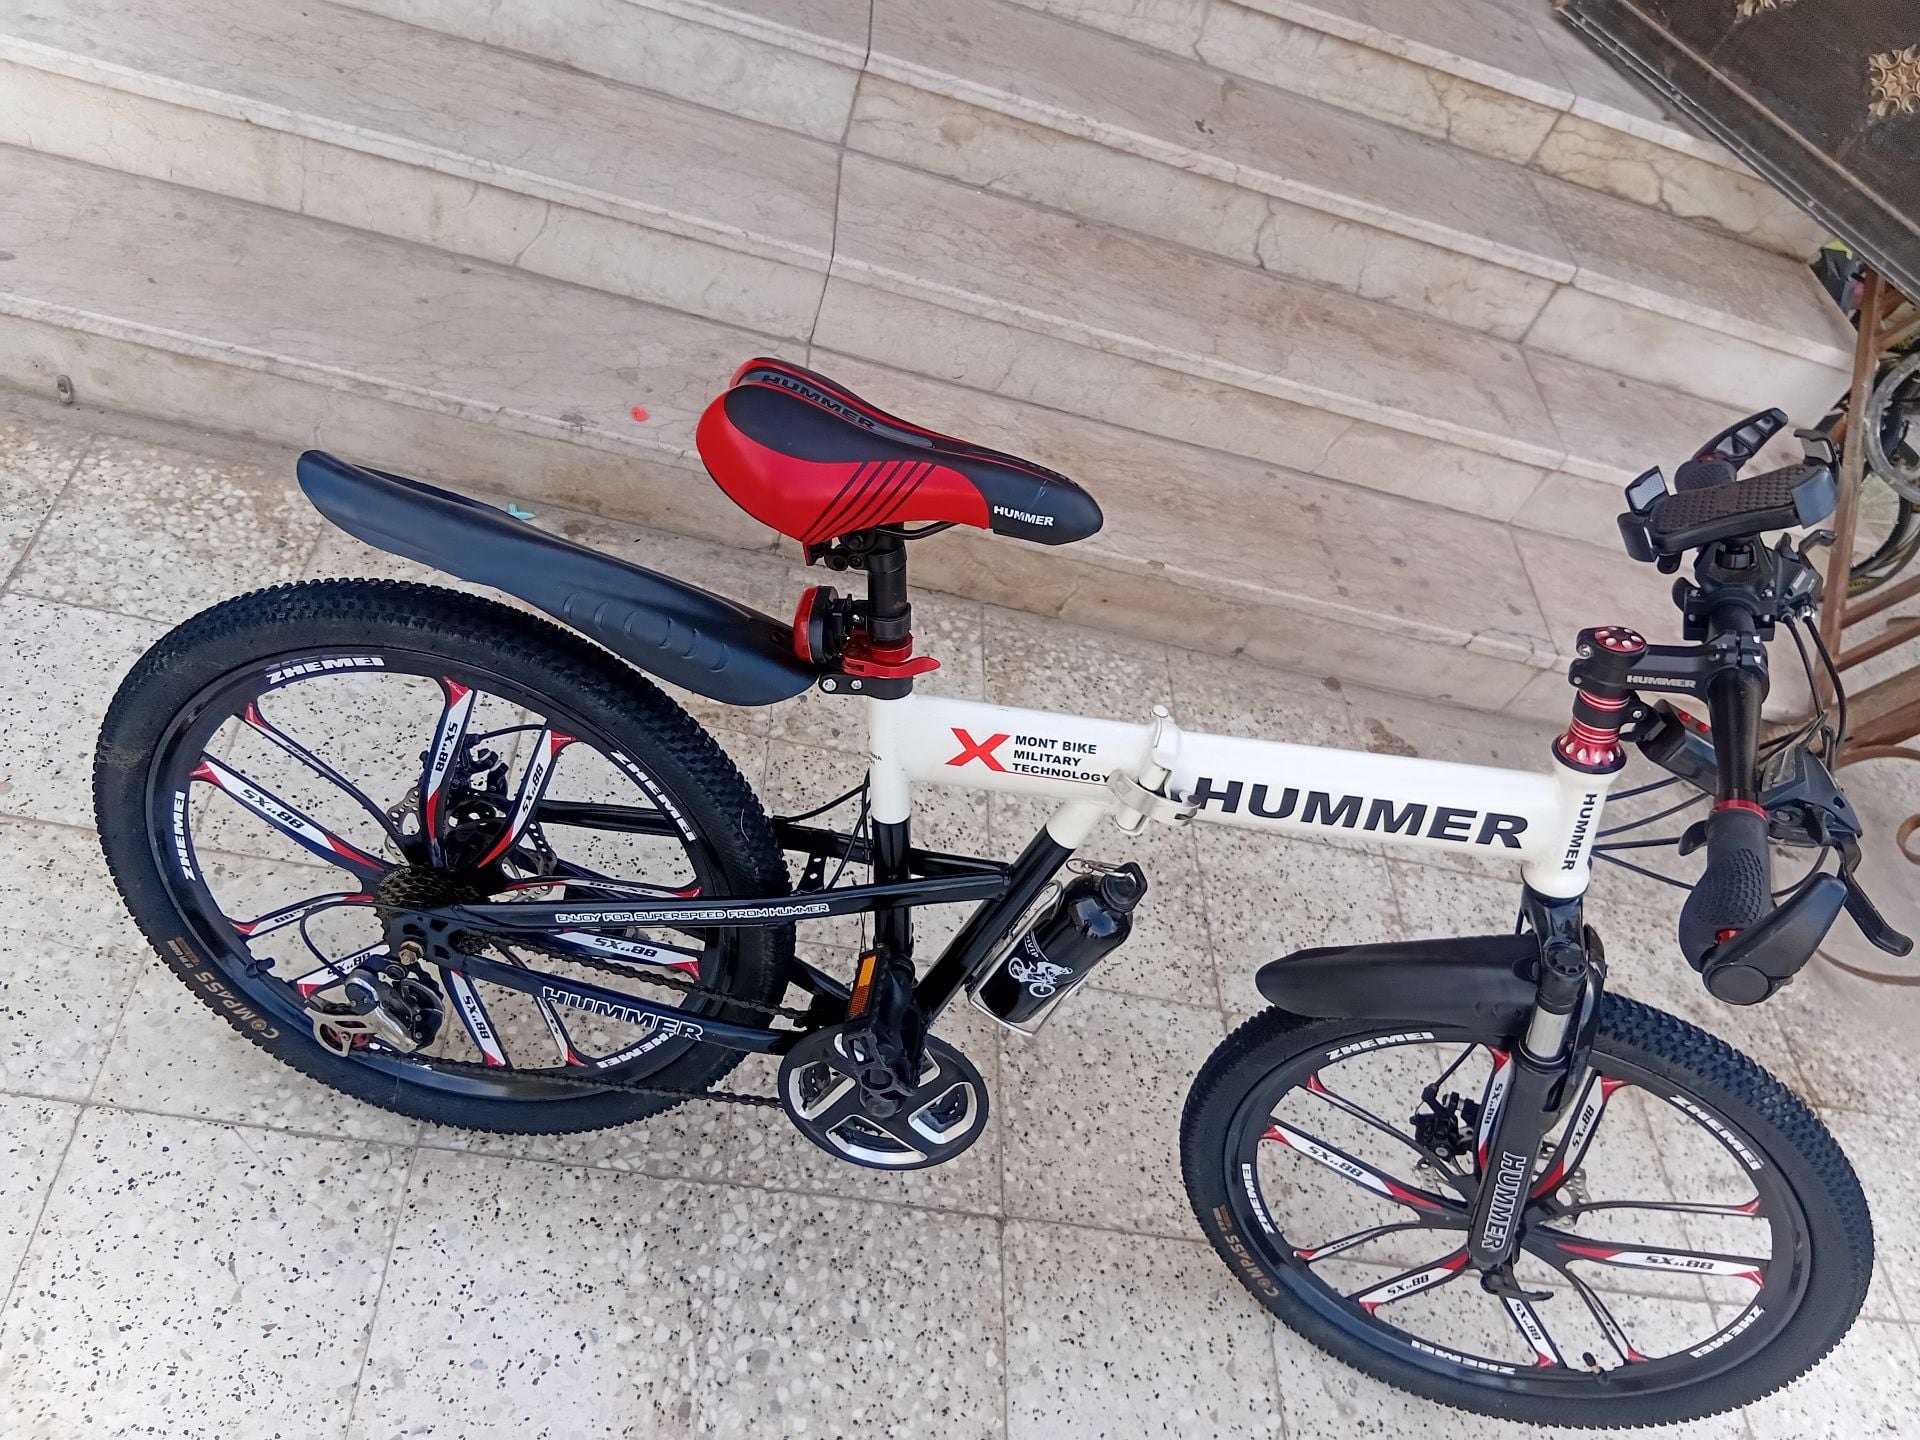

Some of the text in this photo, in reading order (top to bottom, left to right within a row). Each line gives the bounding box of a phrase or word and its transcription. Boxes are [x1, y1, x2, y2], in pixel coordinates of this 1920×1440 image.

[761, 374, 875, 431] HUMMER
[993, 504, 1055, 527] HUMMER
[266, 656, 385, 685] ZHEMEI
[1626, 674, 1697, 689] HUMMER
[944, 727, 1011, 773] X
[1011, 762, 1111, 784] TECHNOLOGY
[1012, 749, 1082, 767] MILITARY
[1014, 734, 1098, 755] MONT BIKE
[610, 749, 697, 842] ZHEMEI
[1195, 776, 1529, 850] HUMMER
[172, 790, 196, 882] ZHEMEI
[1561, 792, 1598, 871] HUMMER
[554, 902, 831, 924] ENJOY FOR SUPERSPEED FROM HUMMER
[194, 970, 280, 1040] COMPASS
[542, 985, 705, 1042] HUMMER
[1325, 1030, 1435, 1061] ZHEMEI
[1669, 1094, 1763, 1171] ZHEMEI
[1241, 1163, 1275, 1235] ZHEMEI
[1481, 1150, 1528, 1251] HUMMER
[1224, 1233, 1280, 1298] COMPASS
[1688, 1304, 1765, 1359] ZHEMEI
